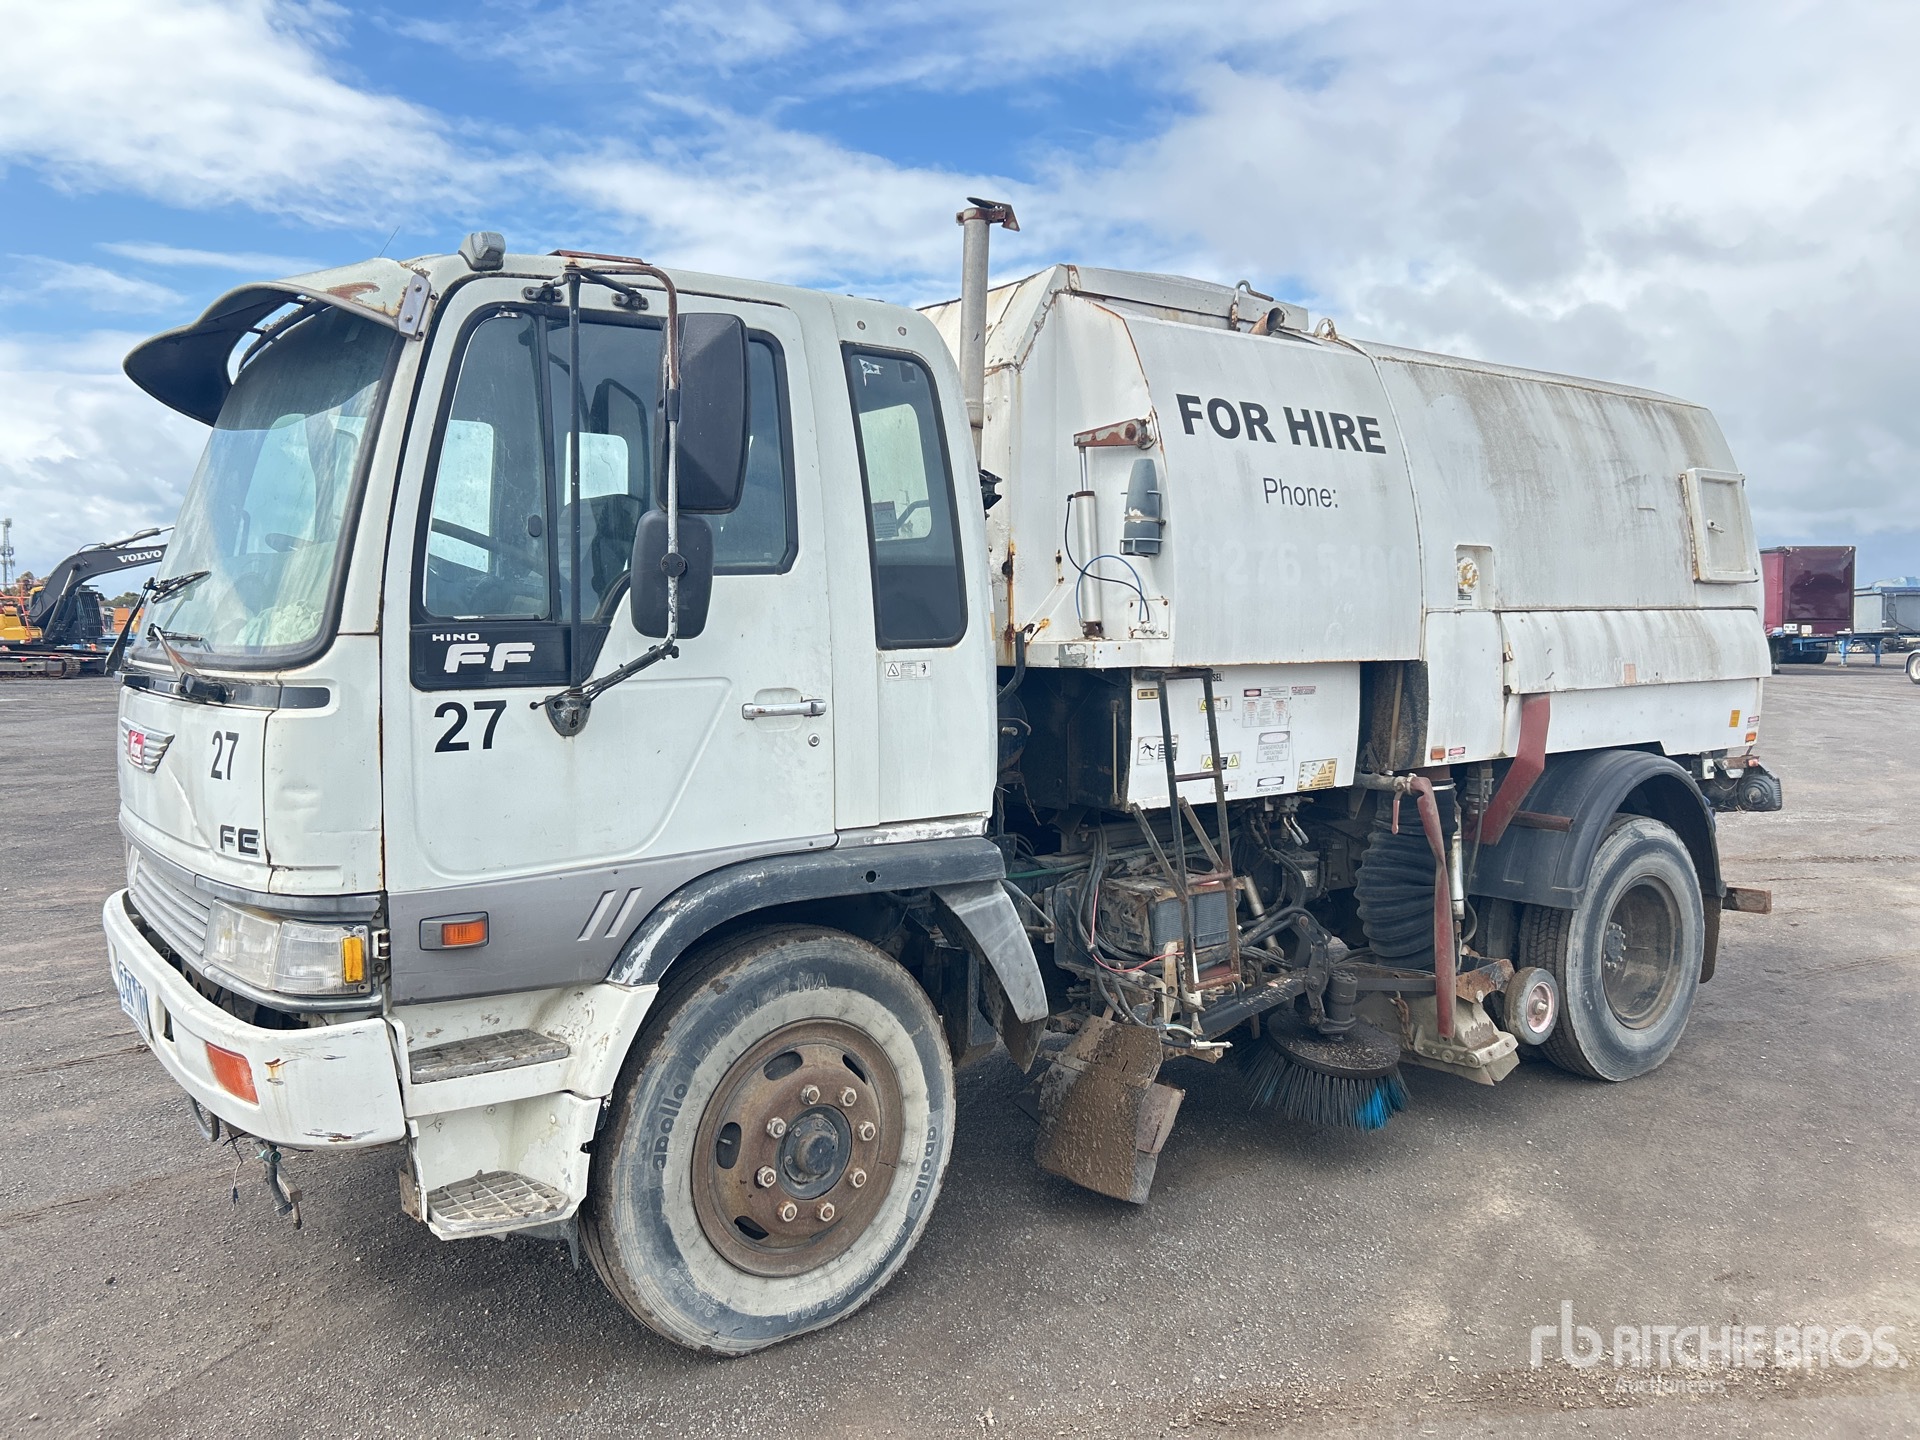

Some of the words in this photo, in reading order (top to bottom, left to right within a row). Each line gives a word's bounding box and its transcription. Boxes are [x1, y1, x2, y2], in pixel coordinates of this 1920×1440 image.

[1175, 393, 1277, 443] FOR
[1283, 406, 1387, 455] HIRE
[1262, 477, 1339, 508] Phone:
[117, 549, 163, 563] VOLVO
[431, 632, 480, 642] HINO
[443, 642, 536, 674] FF
[434, 699, 507, 753] 27
[210, 730, 240, 781] 27
[219, 824, 261, 856] FE
[652, 1083, 688, 1171] apollo
[911, 1126, 937, 1203] apollo
